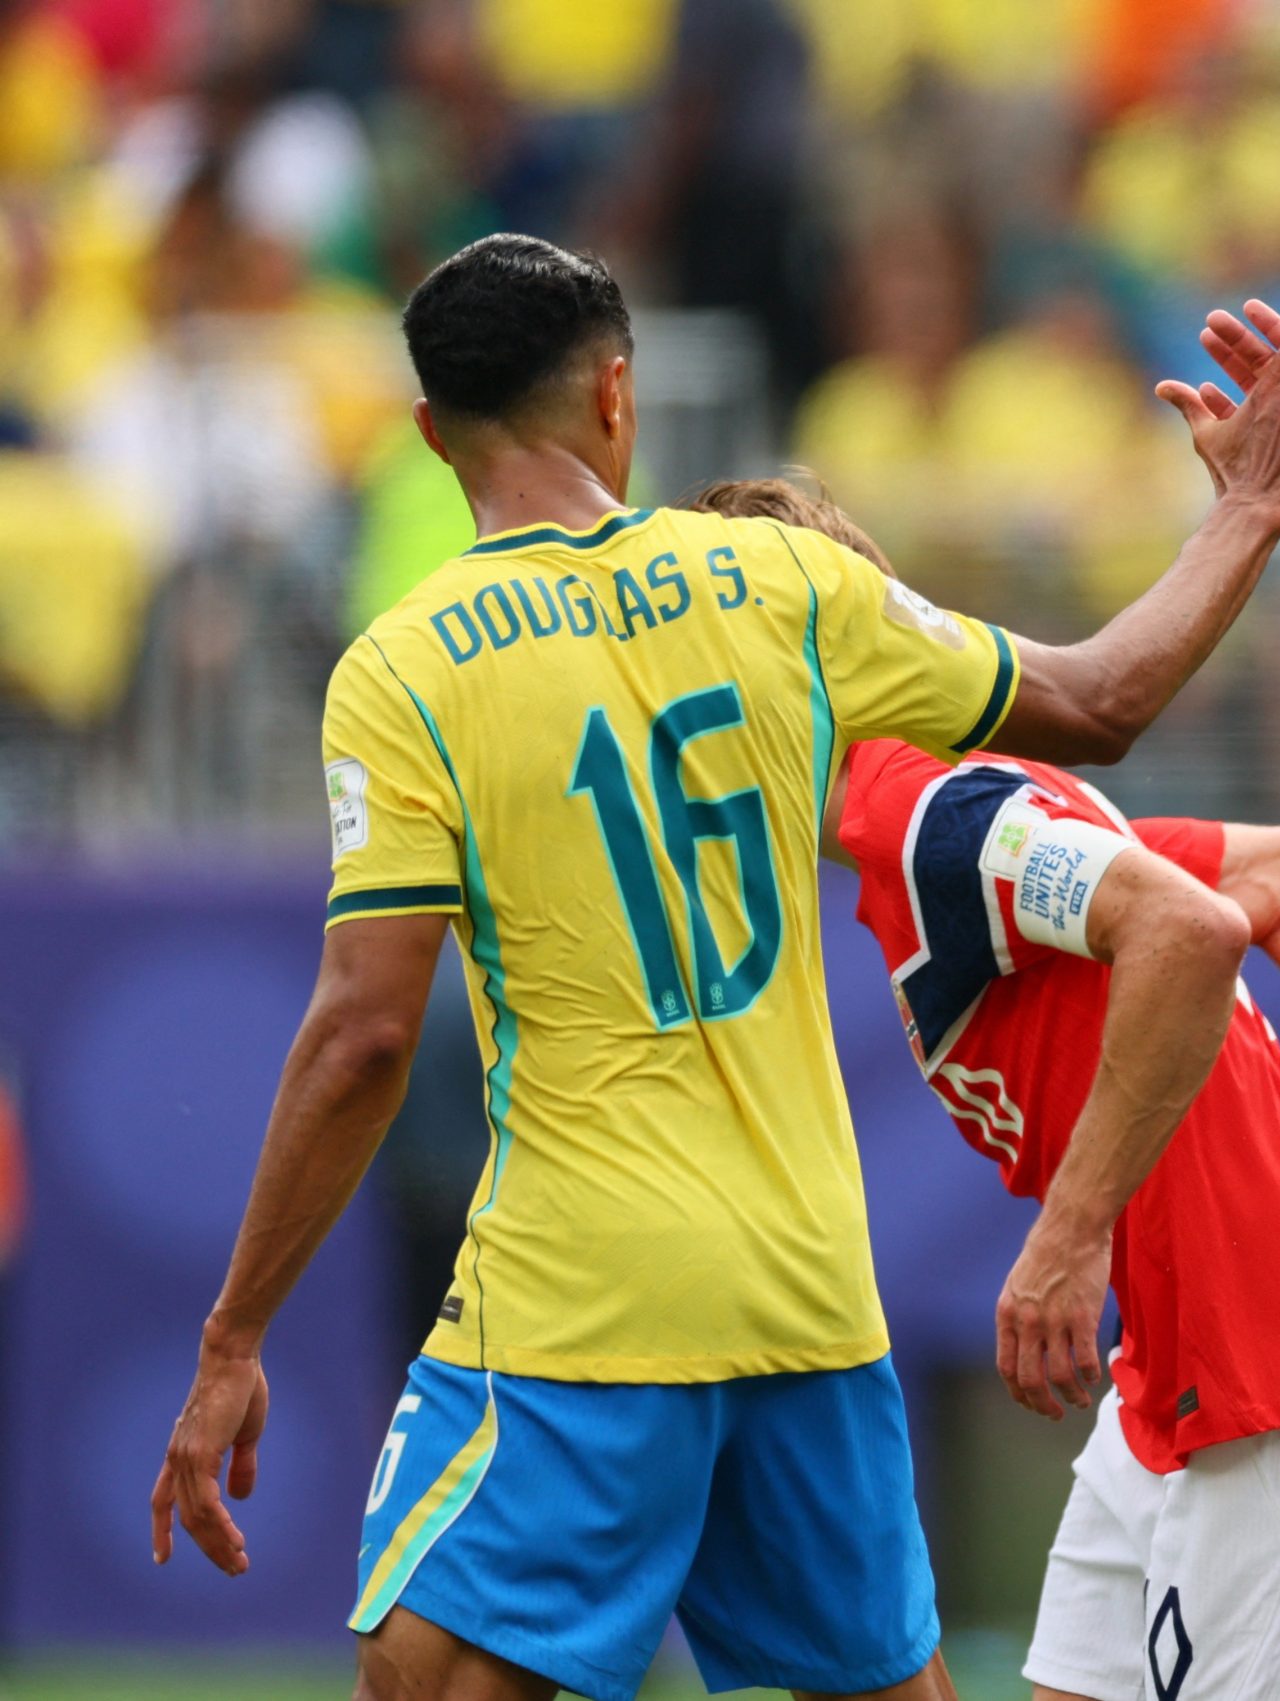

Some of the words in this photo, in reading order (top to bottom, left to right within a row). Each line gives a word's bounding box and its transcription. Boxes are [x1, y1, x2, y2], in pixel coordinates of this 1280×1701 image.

[429, 551, 692, 666] DOUGLAS
[705, 546, 765, 610] S.
[565, 682, 783, 1033] 16
[1020, 842, 1052, 912] FOOTBALL
[1034, 844, 1068, 919] UNITES
[1052, 848, 1087, 902] World
[1144, 1578, 1194, 1701] 0
